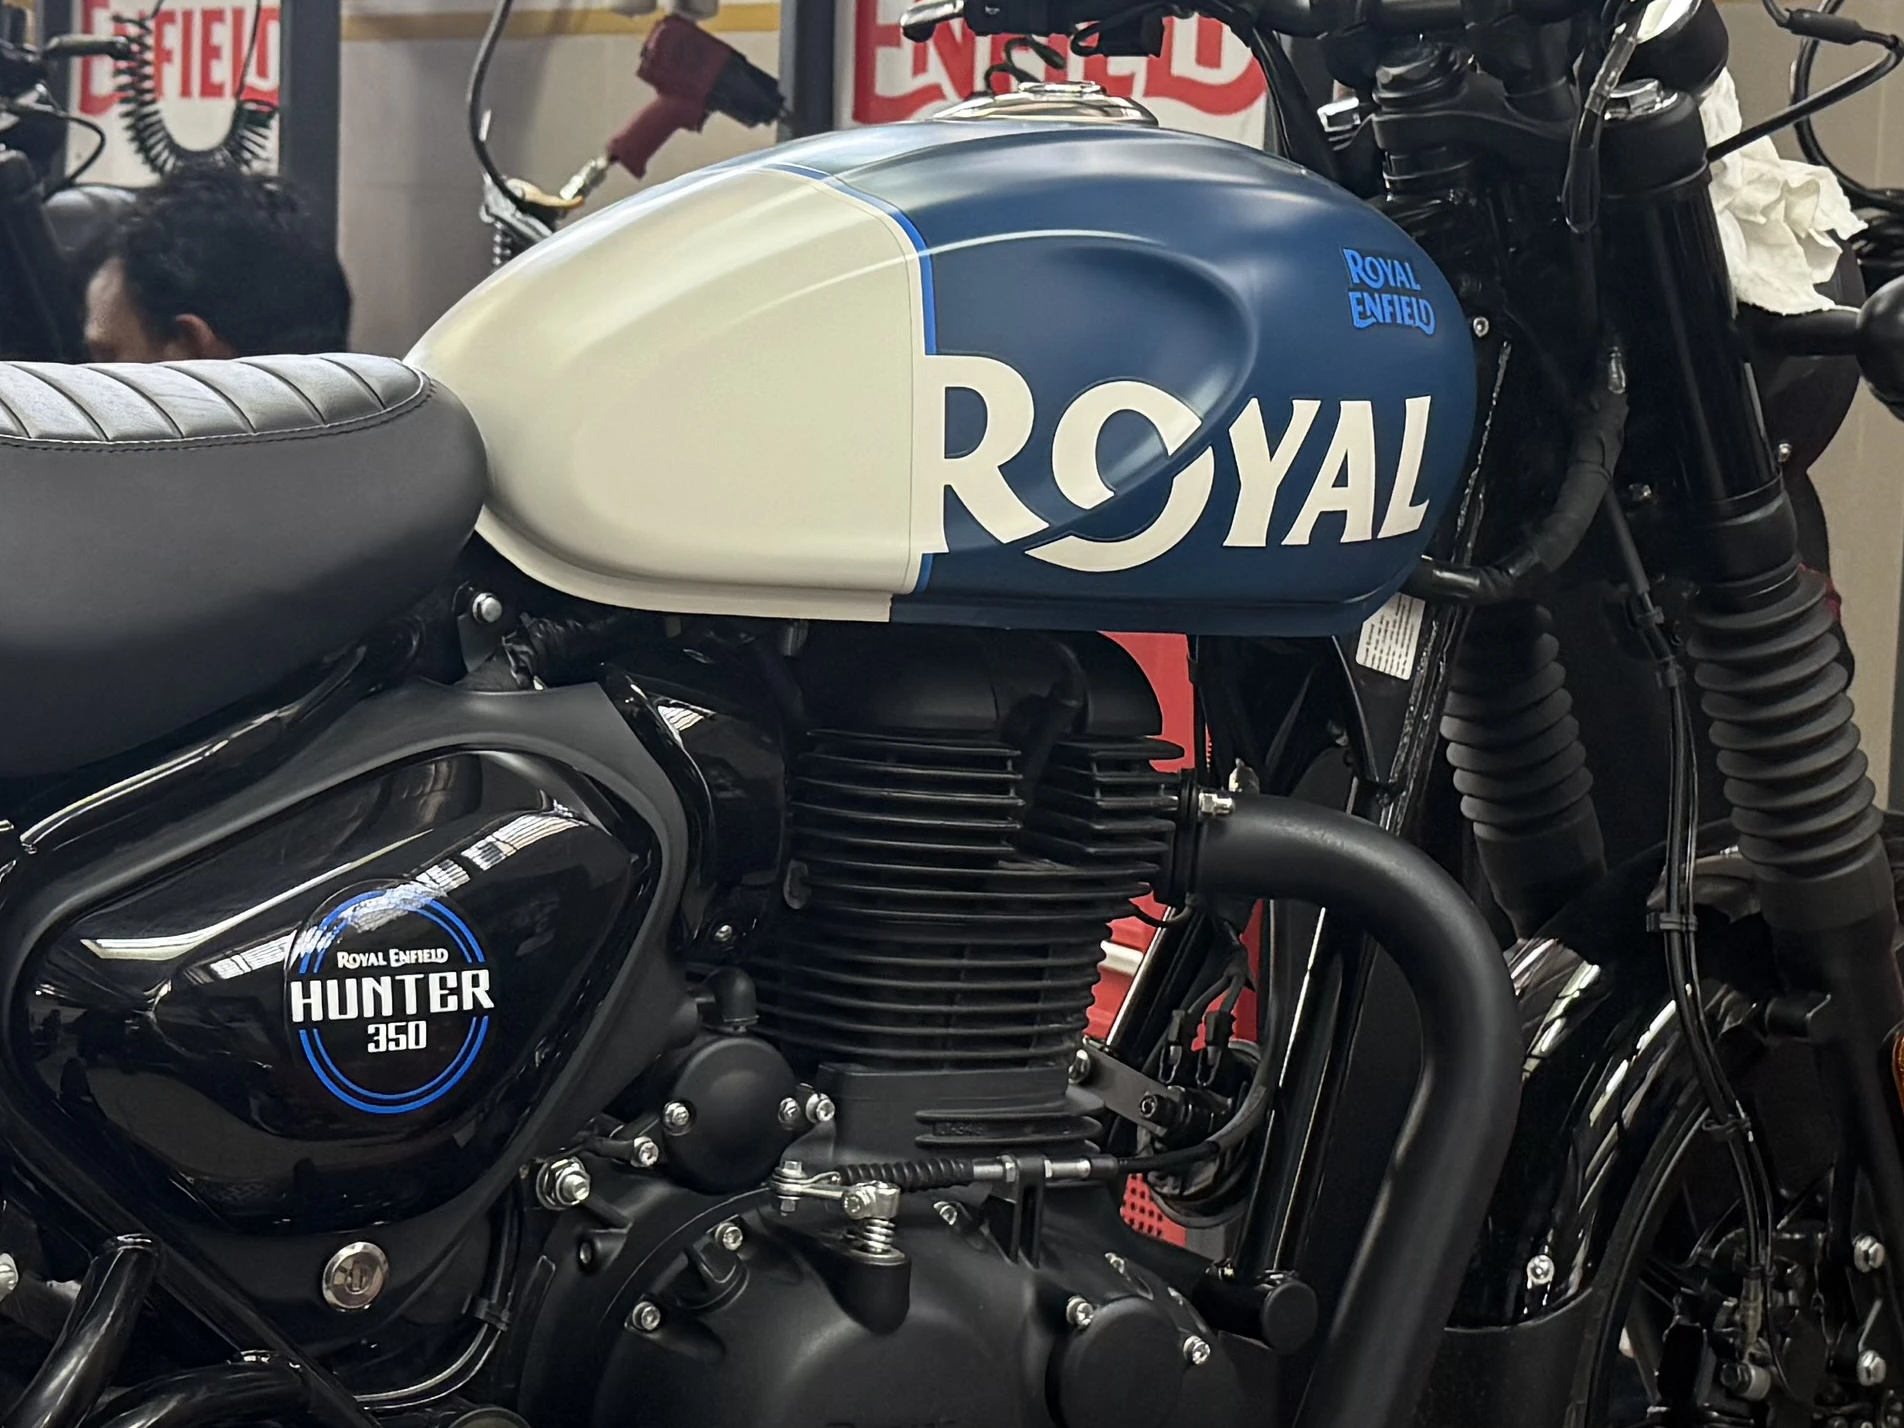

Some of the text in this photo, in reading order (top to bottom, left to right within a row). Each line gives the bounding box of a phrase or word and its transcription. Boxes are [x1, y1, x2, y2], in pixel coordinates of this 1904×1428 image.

[1342, 248, 1421, 292] ROYAL
[1349, 291, 1436, 335] ENFIELD
[921, 355, 1432, 572] ROYAL
[337, 948, 449, 970] ROYAL ENFIELD
[290, 968, 495, 1024] HUNTER
[367, 1020, 427, 1054] 350
